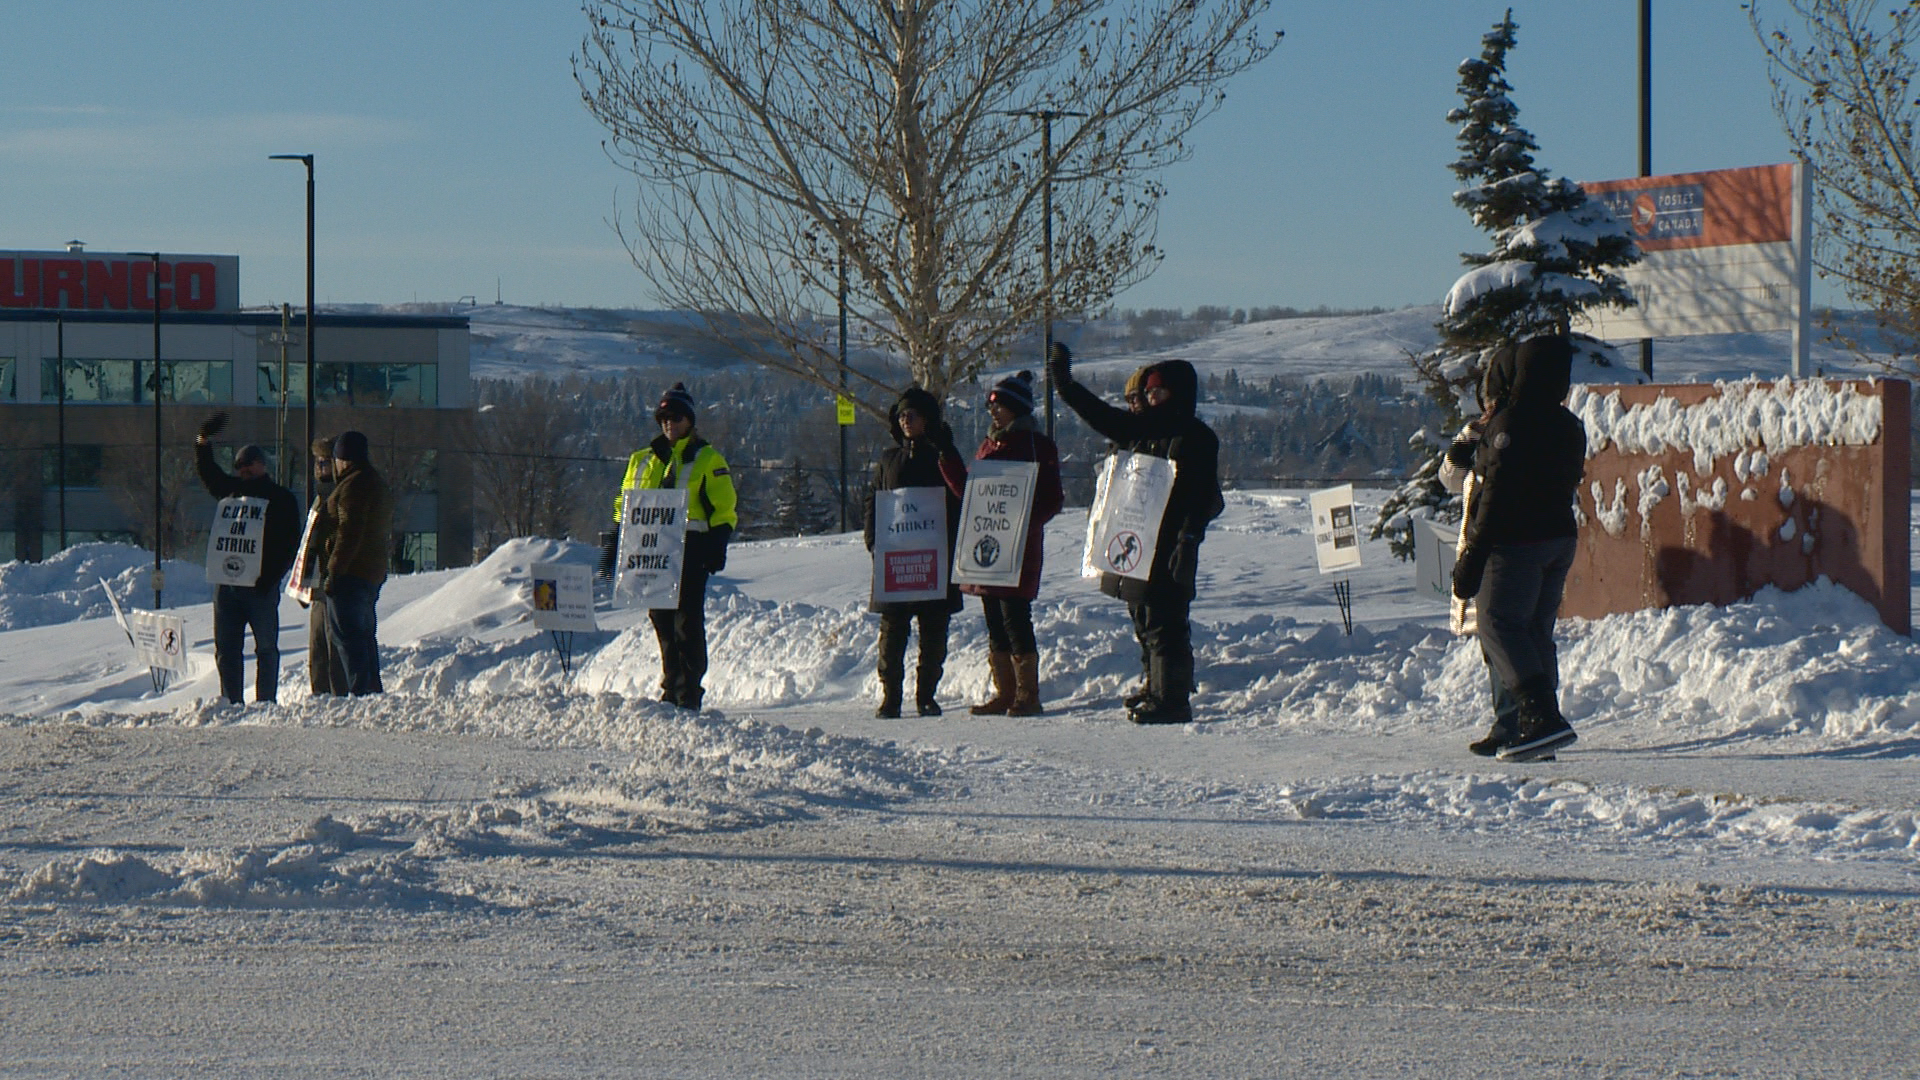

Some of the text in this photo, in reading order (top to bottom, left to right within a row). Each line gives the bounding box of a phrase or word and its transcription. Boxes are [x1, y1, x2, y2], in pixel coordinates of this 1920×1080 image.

[1658, 193, 1694, 206] POSTES
[1657, 218, 1698, 232] CANADA
[977, 484, 1019, 498] UNITED
[902, 503, 919, 514] ON
[987, 501, 1006, 514] WE
[631, 507, 676, 525] CUPW
[230, 521, 247, 535] ON
[888, 519, 935, 533] STRIKE!
[973, 515, 1011, 533] STAND
[216, 537, 257, 554] STRIKE
[641, 533, 658, 548] ON
[627, 554, 670, 569] STRIKE
[906, 563, 931, 574] BETTER
